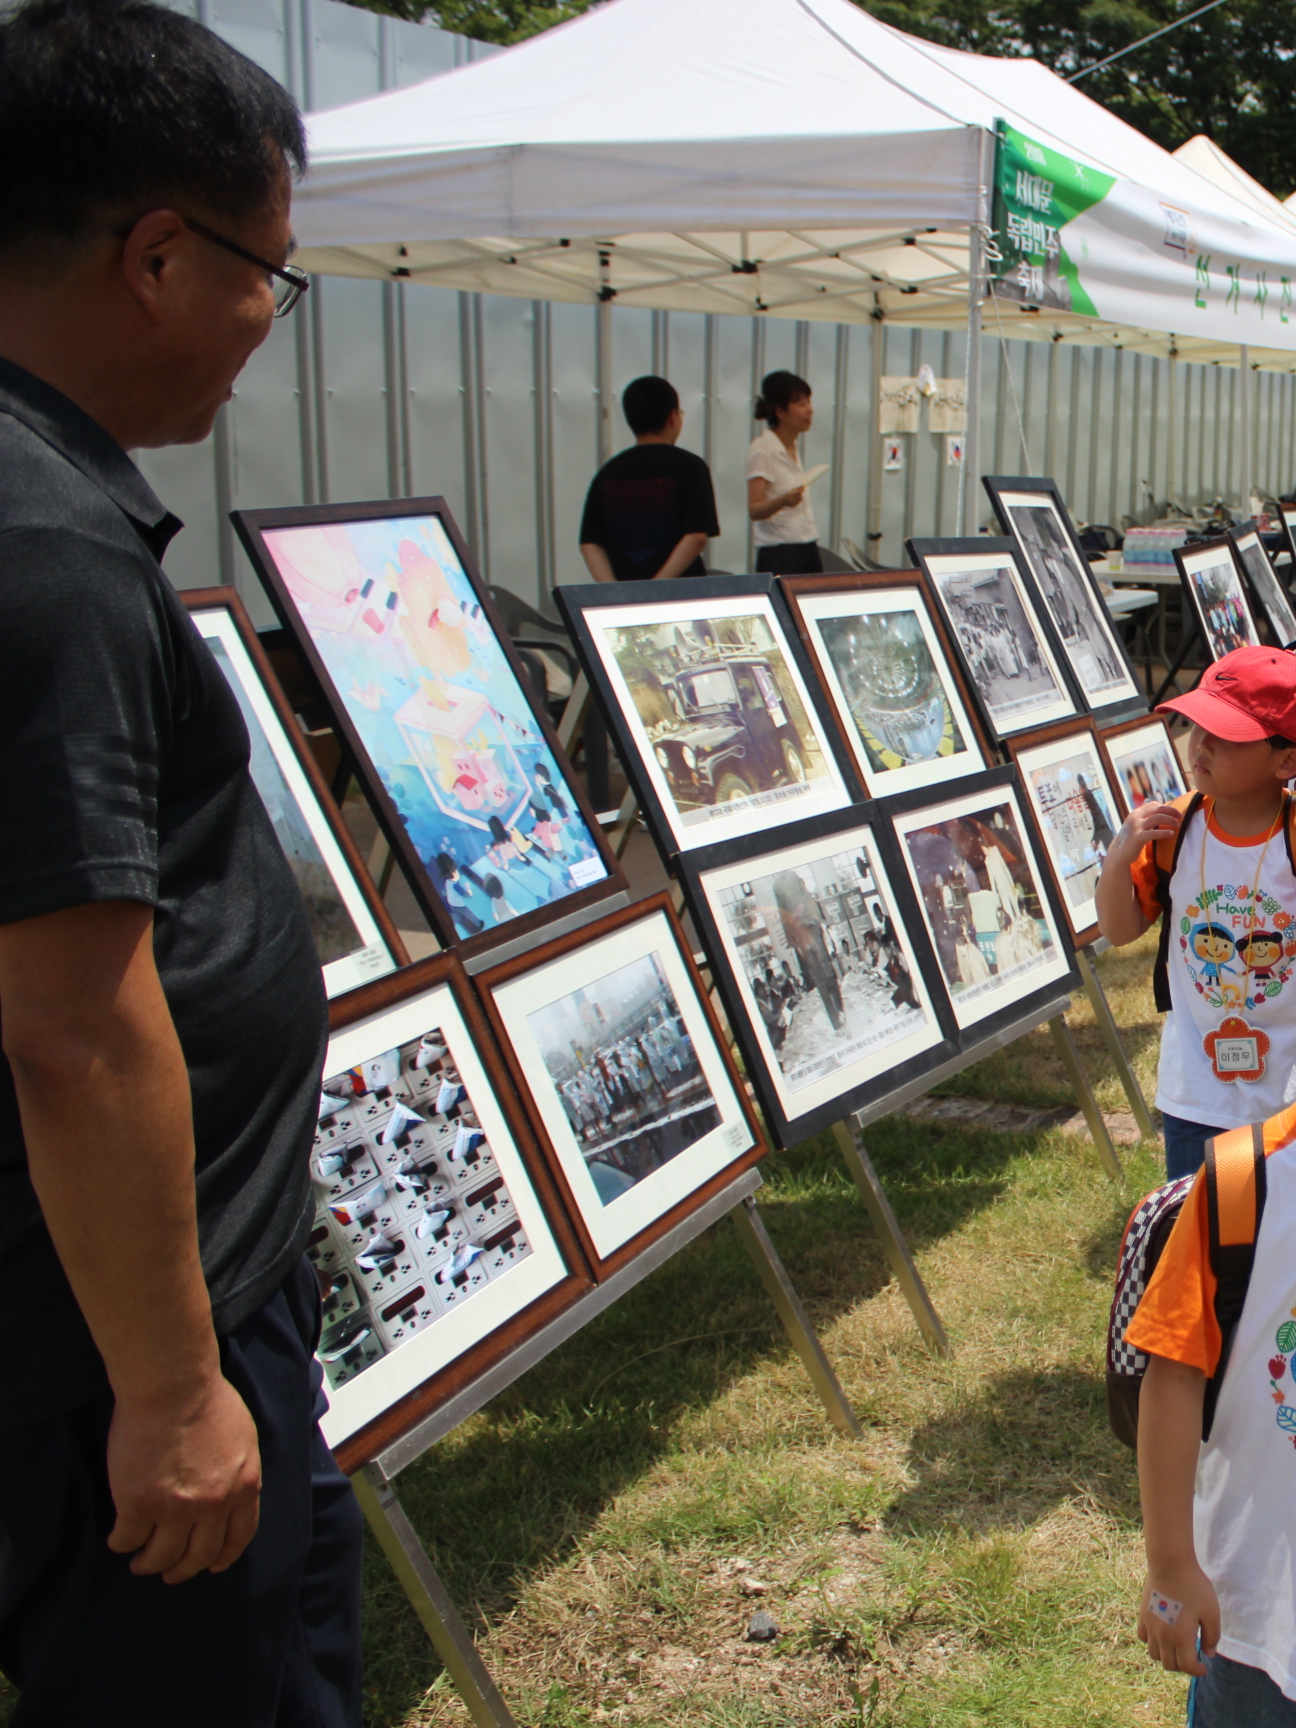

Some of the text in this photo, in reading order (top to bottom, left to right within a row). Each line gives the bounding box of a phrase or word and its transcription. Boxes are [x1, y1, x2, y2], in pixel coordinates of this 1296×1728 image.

[1014, 169, 1055, 216] 서대문
[1006, 211, 1061, 259] 독립민주
[1016, 259, 1045, 301] 축제
[1216, 902, 1256, 917] Have
[1231, 915, 1267, 930] FUN
[1221, 1051, 1251, 1062] 이정우
